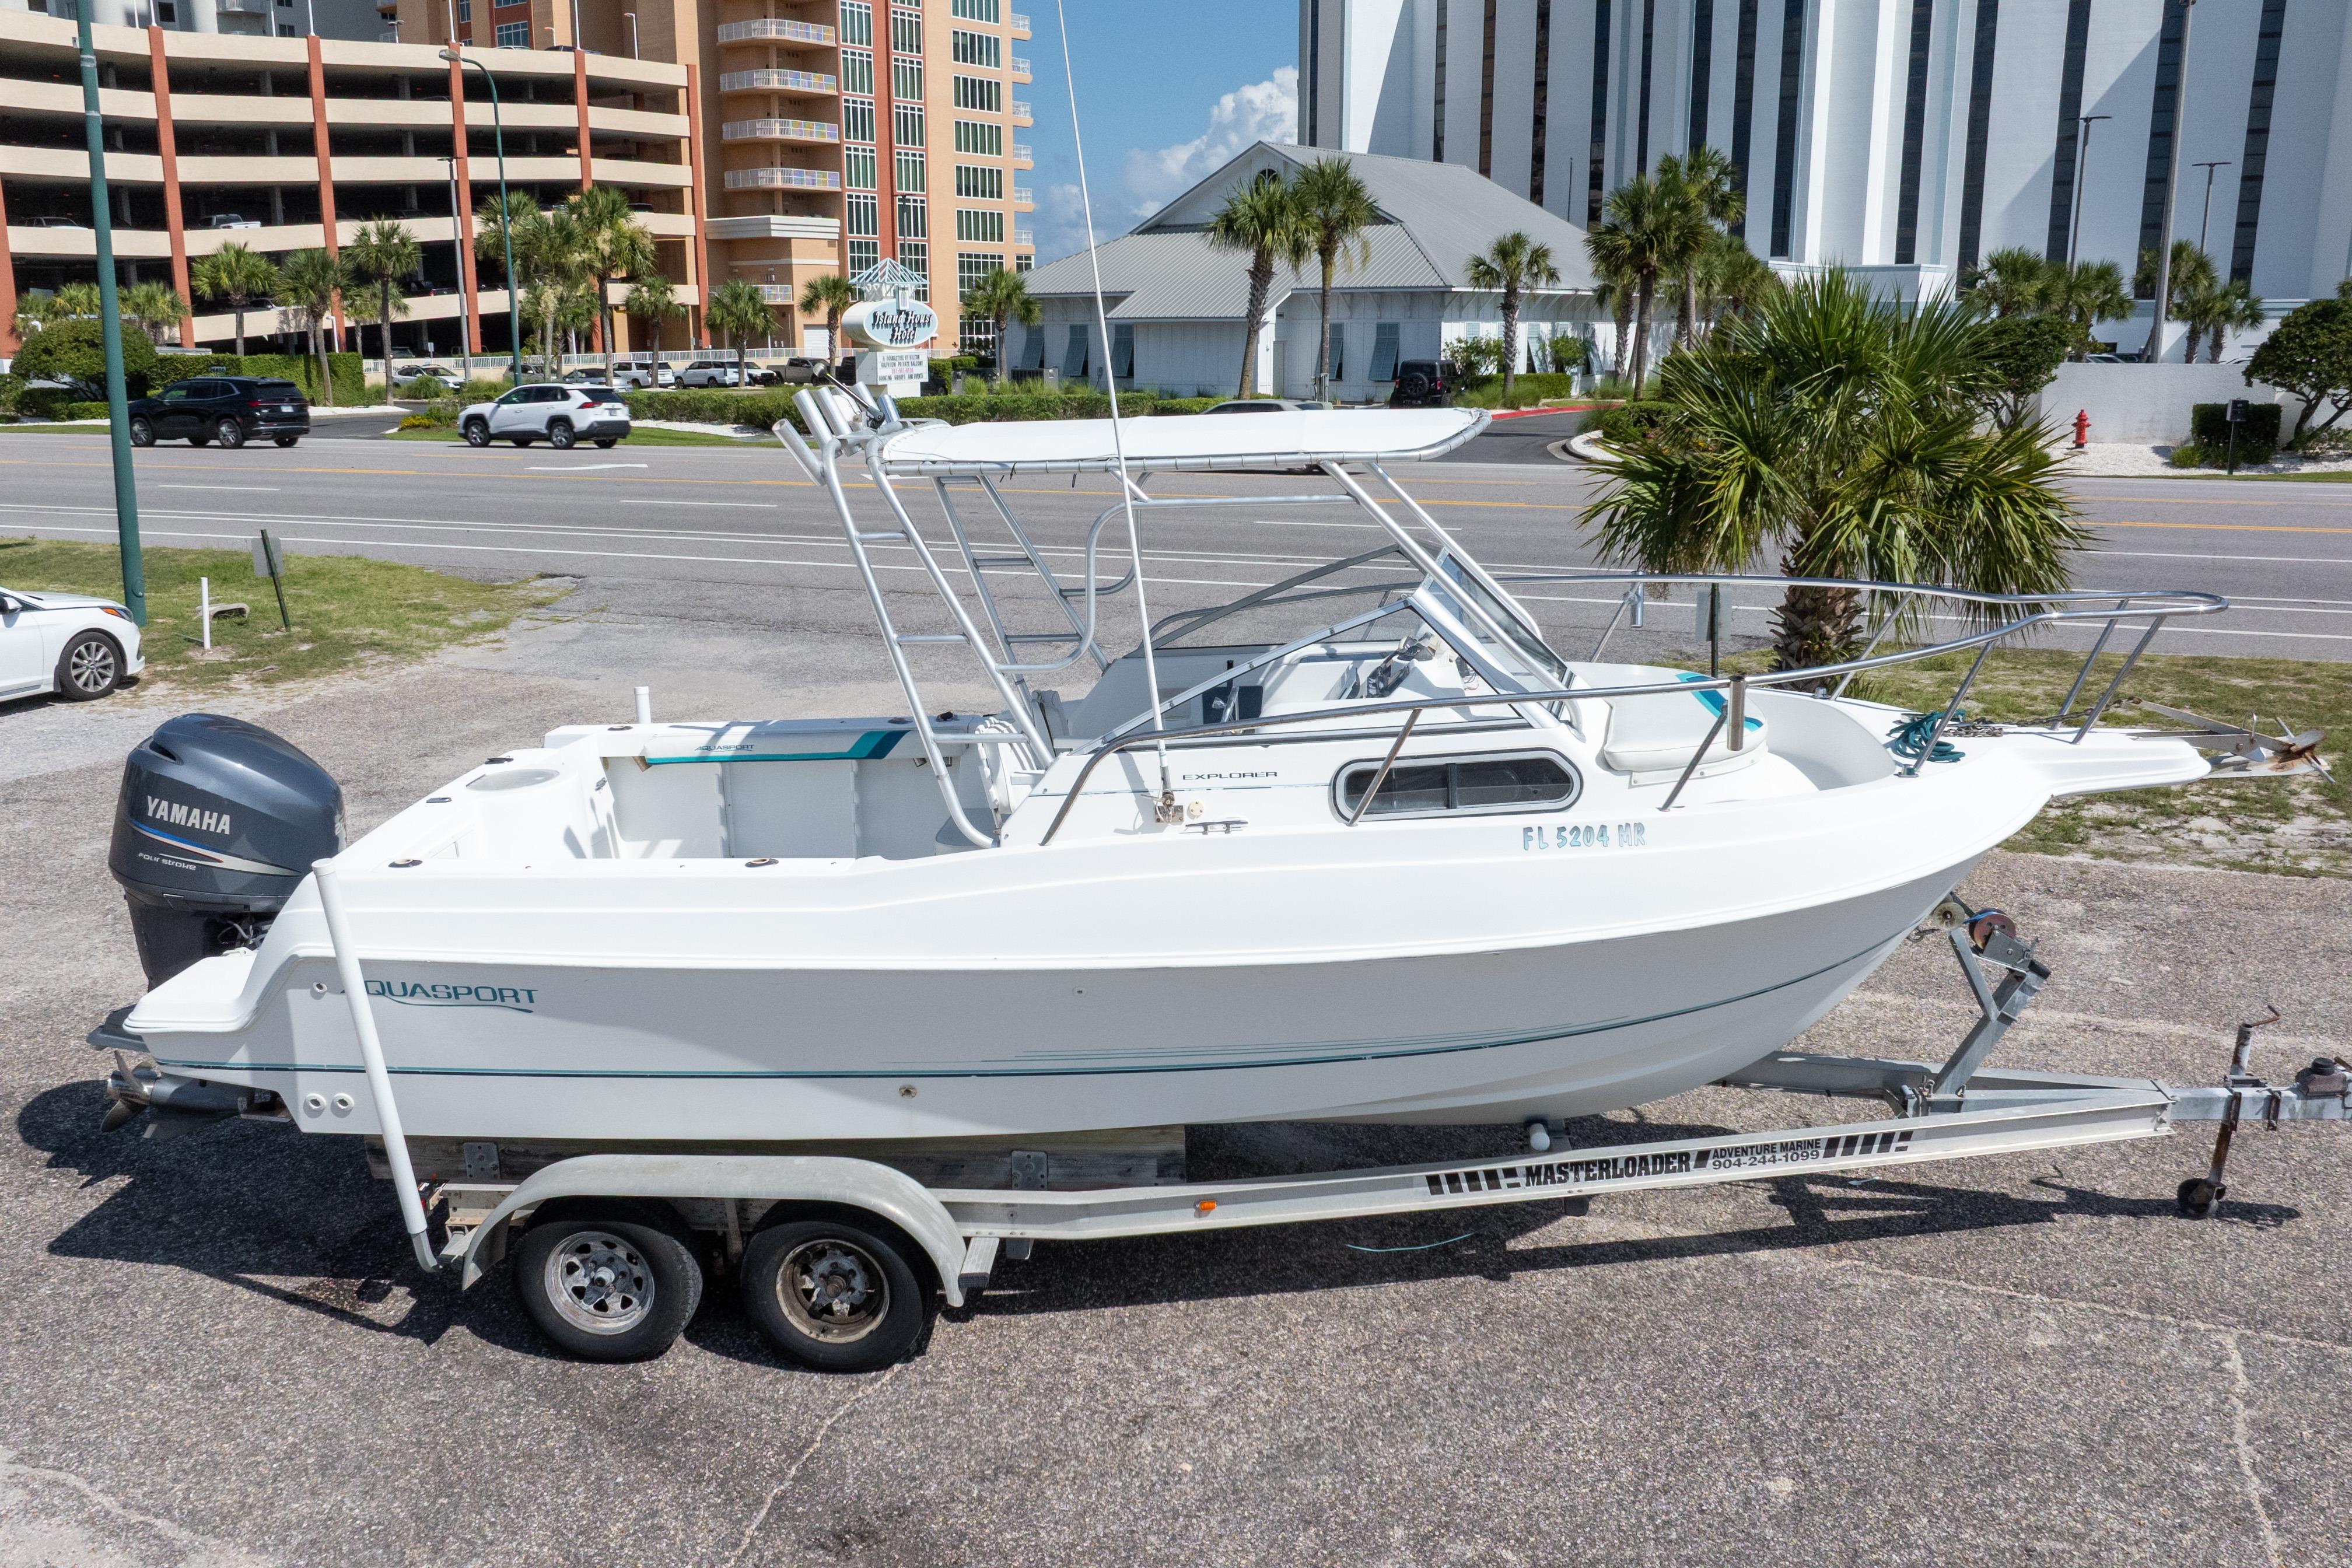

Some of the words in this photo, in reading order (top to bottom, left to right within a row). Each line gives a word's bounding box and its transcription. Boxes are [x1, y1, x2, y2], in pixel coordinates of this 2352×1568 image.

[874, 310, 905, 325] Island
[907, 310, 933, 324] House
[893, 327, 918, 341] Hotel
[1182, 771, 1278, 780] EXPLORER
[146, 795, 230, 835] YAMAHA
[1522, 825, 1549, 851] FL
[1556, 824, 1609, 849] 5204
[1618, 821, 1646, 848] MR
[341, 980, 539, 1003] QUASPORT
[1712, 1143, 1777, 1160] ADVENTURE
[1779, 1138, 1821, 1152] MARINE
[1712, 1149, 1820, 1170] 904-244-1099
[1525, 1152, 1691, 1188] MASTERLOADER
